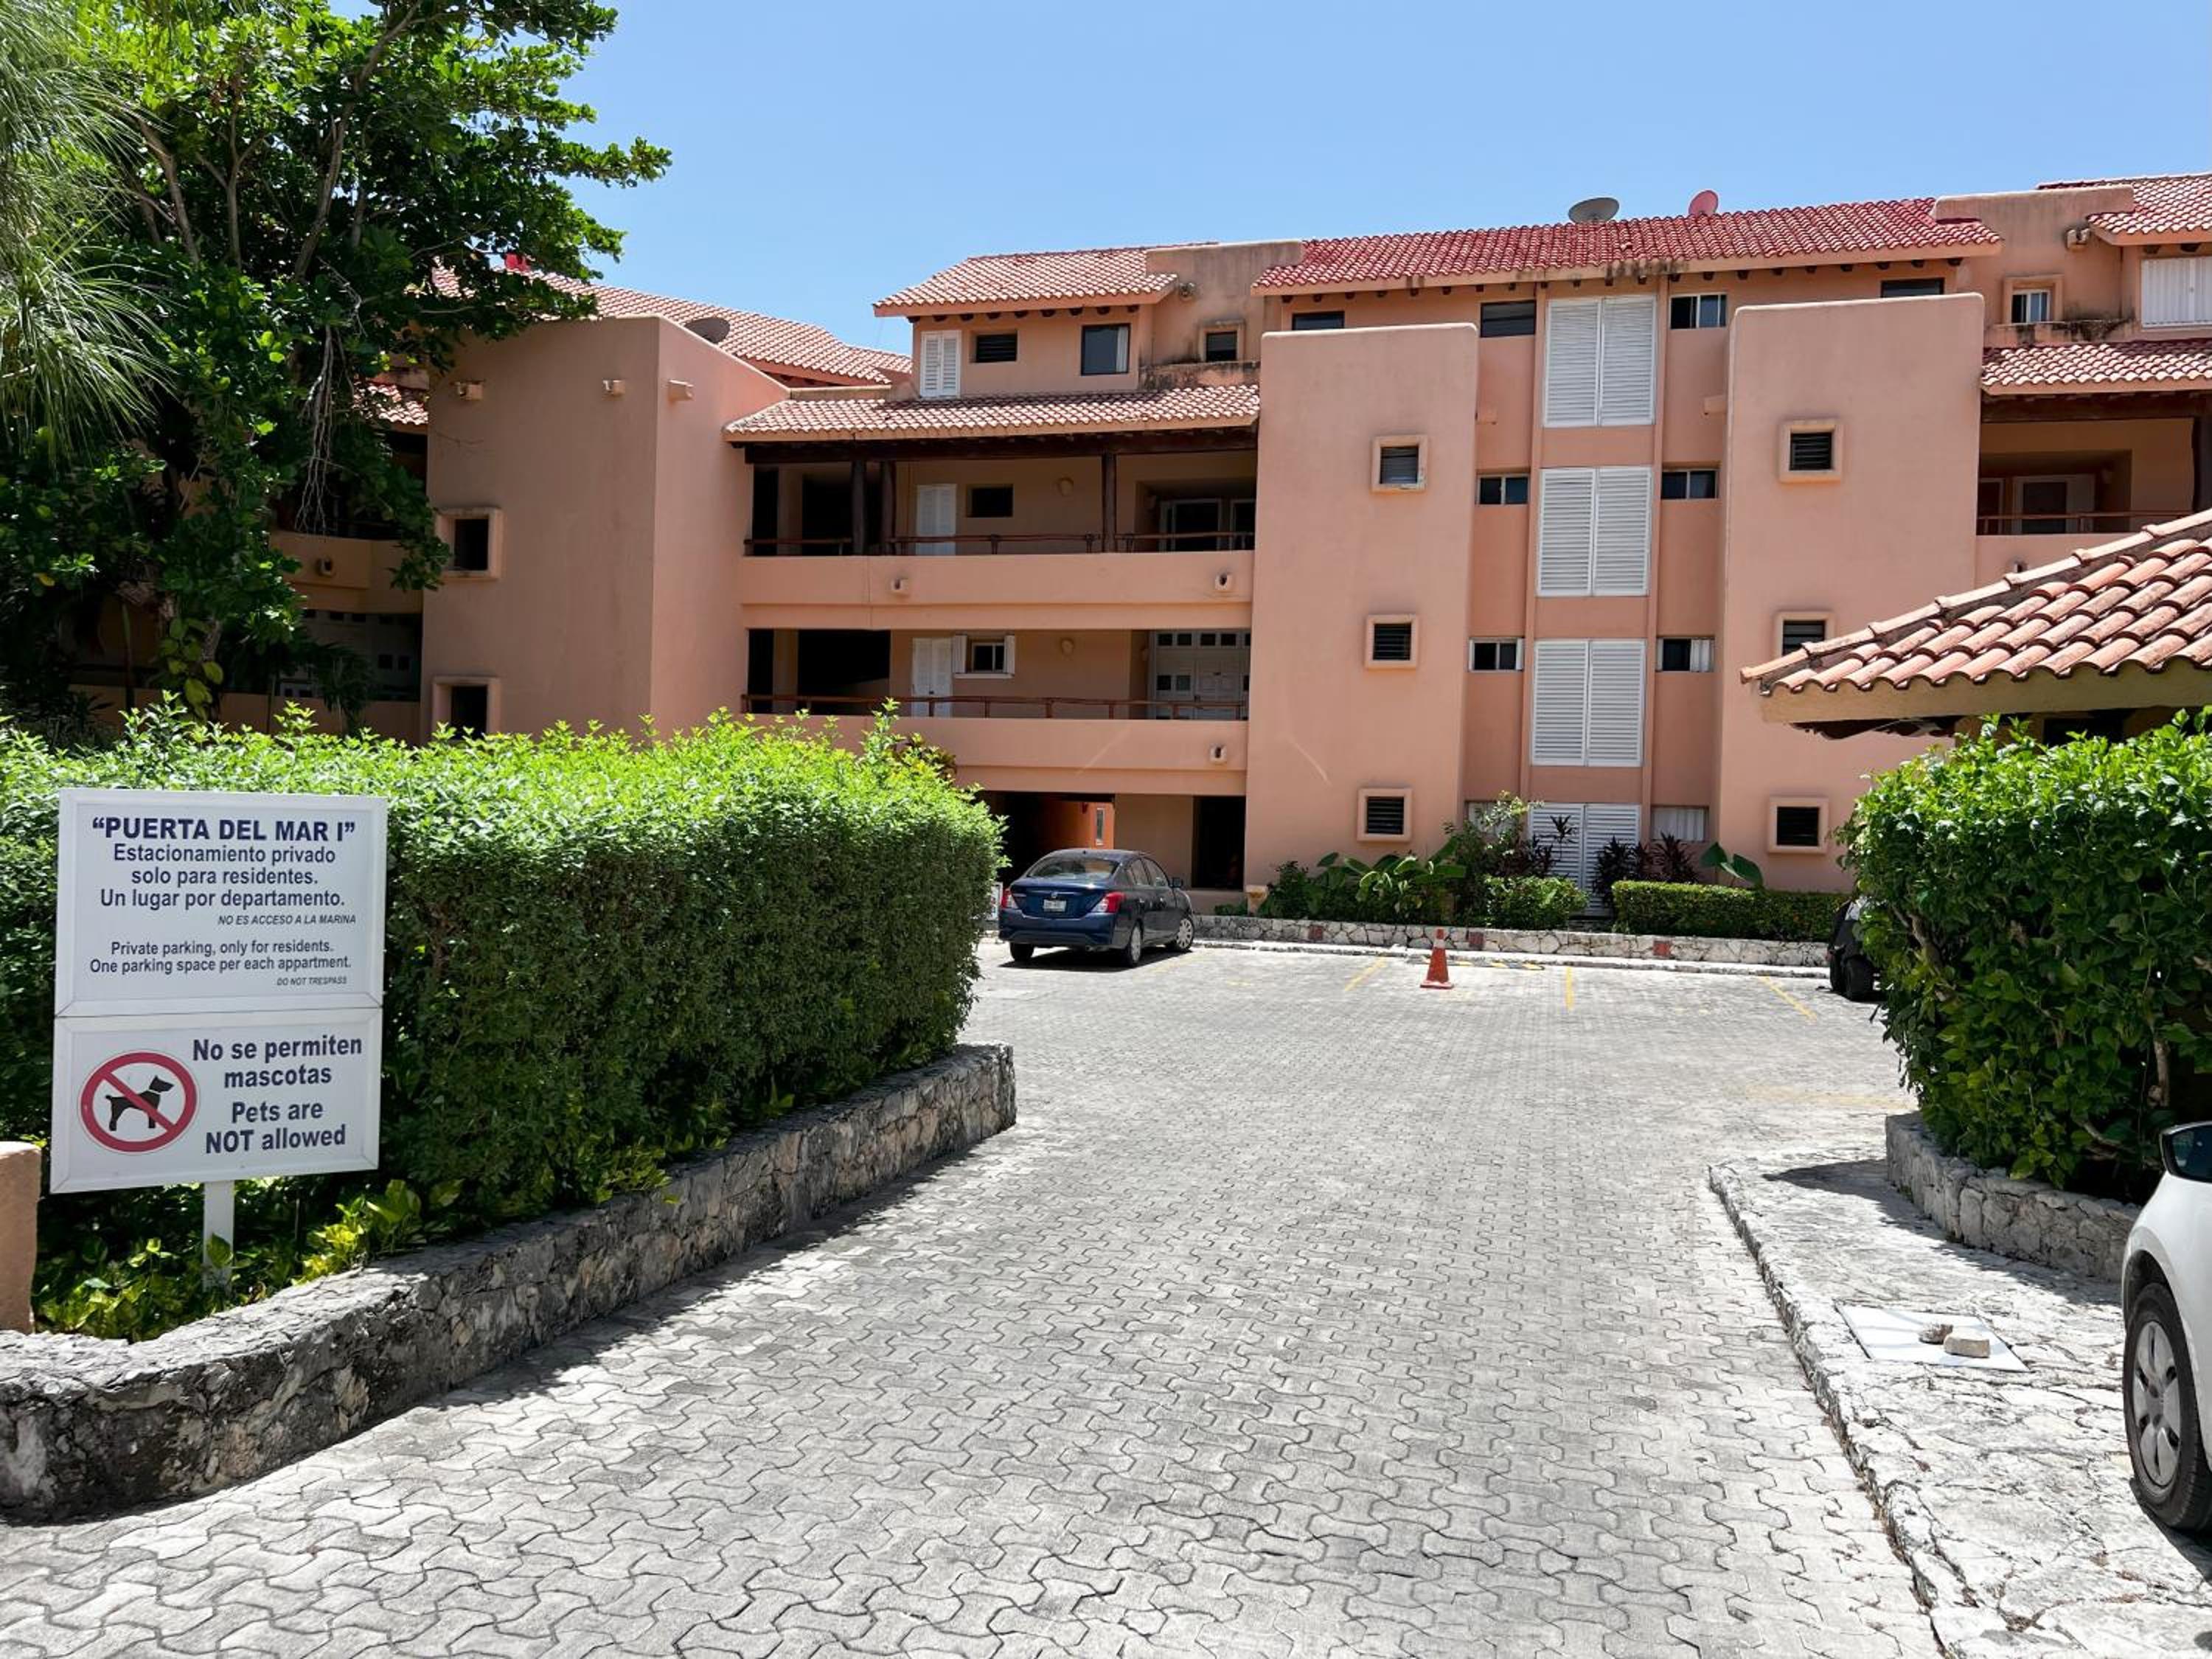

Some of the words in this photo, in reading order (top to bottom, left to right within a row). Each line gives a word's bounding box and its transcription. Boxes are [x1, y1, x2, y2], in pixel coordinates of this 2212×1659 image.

[220, 820, 267, 841] DEL
[276, 821, 328, 841] MAR
[114, 844, 265, 862] Estacionamiento
[272, 846, 335, 866] privado
[132, 867, 171, 883] solo
[178, 871, 216, 888] para
[223, 868, 317, 884] residentes.
[101, 889, 125, 906] Un
[133, 889, 180, 911] lugar
[185, 894, 215, 910] por
[221, 889, 344, 910] departamento.
[218, 915, 233, 925] NO
[236, 916, 249, 925] ES
[251, 915, 293, 925] ACCESO
[294, 915, 301, 924] A
[304, 915, 316, 924] LA
[319, 914, 355, 924] MARINA
[112, 942, 158, 954] Private
[163, 941, 215, 957] parking,
[220, 940, 247, 956] only
[251, 940, 269, 953] for
[273, 939, 333, 953] residents.
[90, 959, 117, 973] One
[122, 958, 173, 975] parking
[177, 960, 215, 973] space
[220, 960, 240, 973] per
[244, 956, 274, 970] each
[278, 956, 351, 972] appartment.
[277, 978, 289, 986] DO
[291, 977, 307, 985] NOT
[193, 1040, 223, 1060] No
[232, 1043, 257, 1059] se
[265, 1035, 361, 1063] permiten
[225, 1065, 331, 1088] mascotas
[232, 1102, 280, 1124] Pets
[288, 1103, 323, 1120] are
[206, 1130, 254, 1153] NOT
[262, 1124, 345, 1150] allowed
